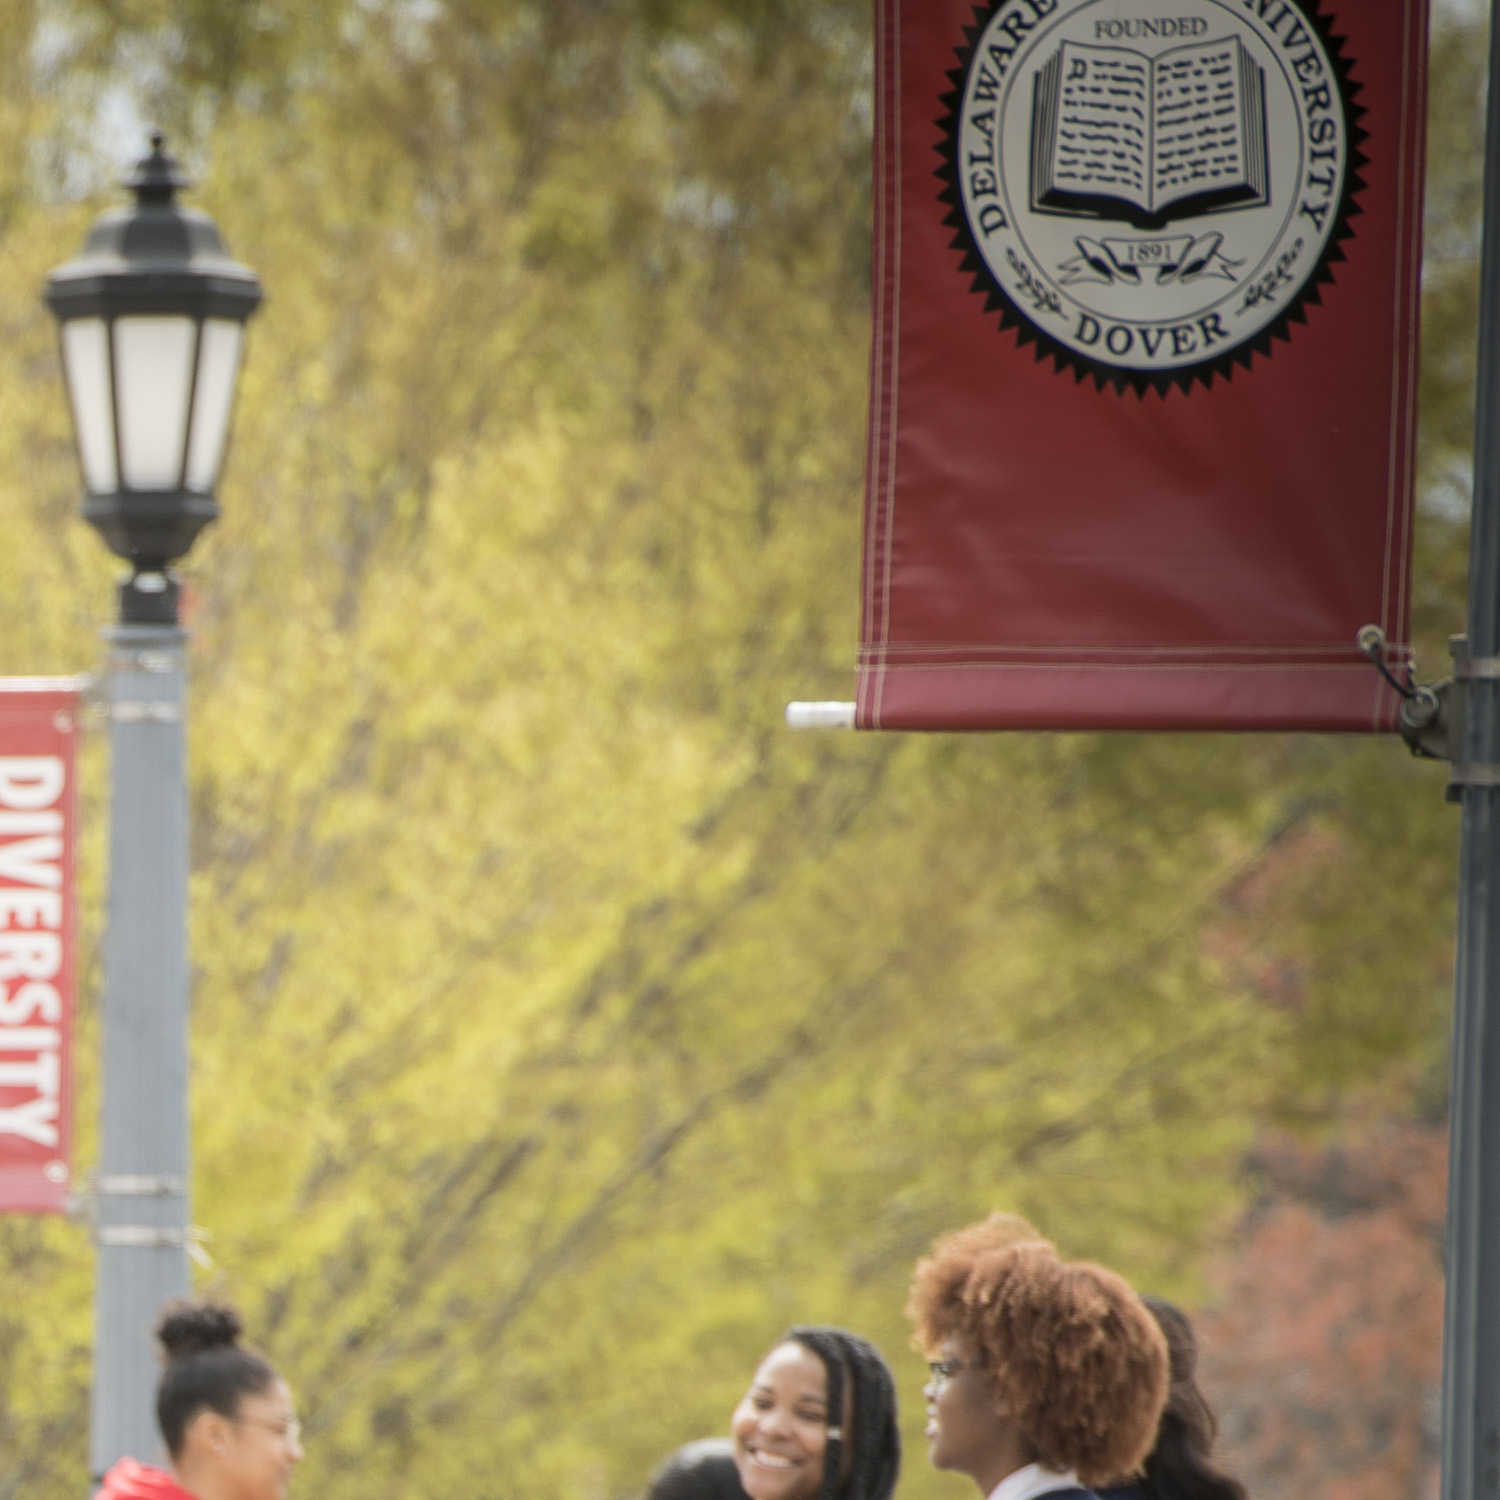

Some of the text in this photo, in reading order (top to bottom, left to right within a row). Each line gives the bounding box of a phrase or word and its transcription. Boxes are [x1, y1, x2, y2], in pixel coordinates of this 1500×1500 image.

[1094, 16, 1208, 40] FOUNDED
[968, 0, 1058, 239] DELAWARE
[1243, 0, 1337, 232] NIVERSITY
[1126, 242, 1172, 263] 1891
[1073, 312, 1230, 357] DOVER
